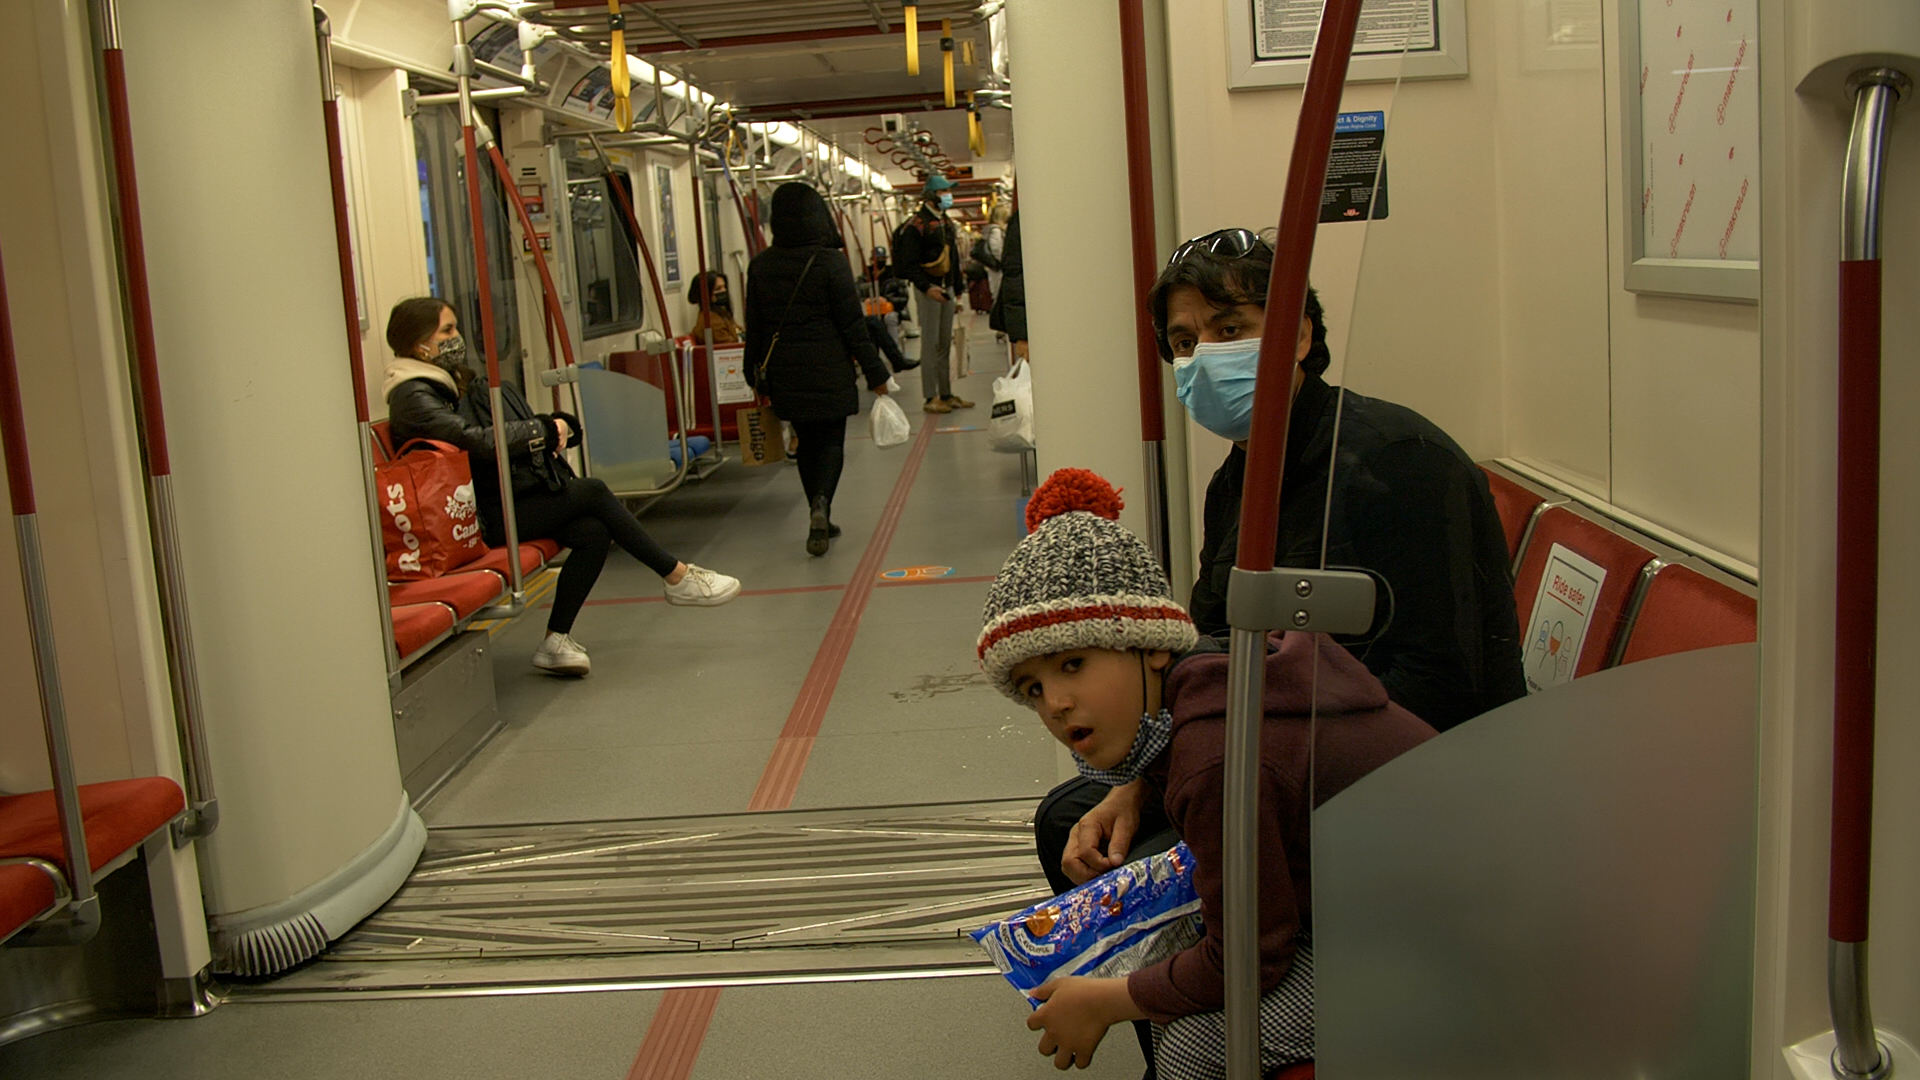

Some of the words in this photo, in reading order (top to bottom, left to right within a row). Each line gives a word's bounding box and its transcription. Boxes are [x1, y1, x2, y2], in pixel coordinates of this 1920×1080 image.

[1353, 115, 1377, 123] Dignity
[386, 483, 422, 573] Roots
[1552, 574, 1569, 597] Ride
[1567, 587, 1586, 607] safer
